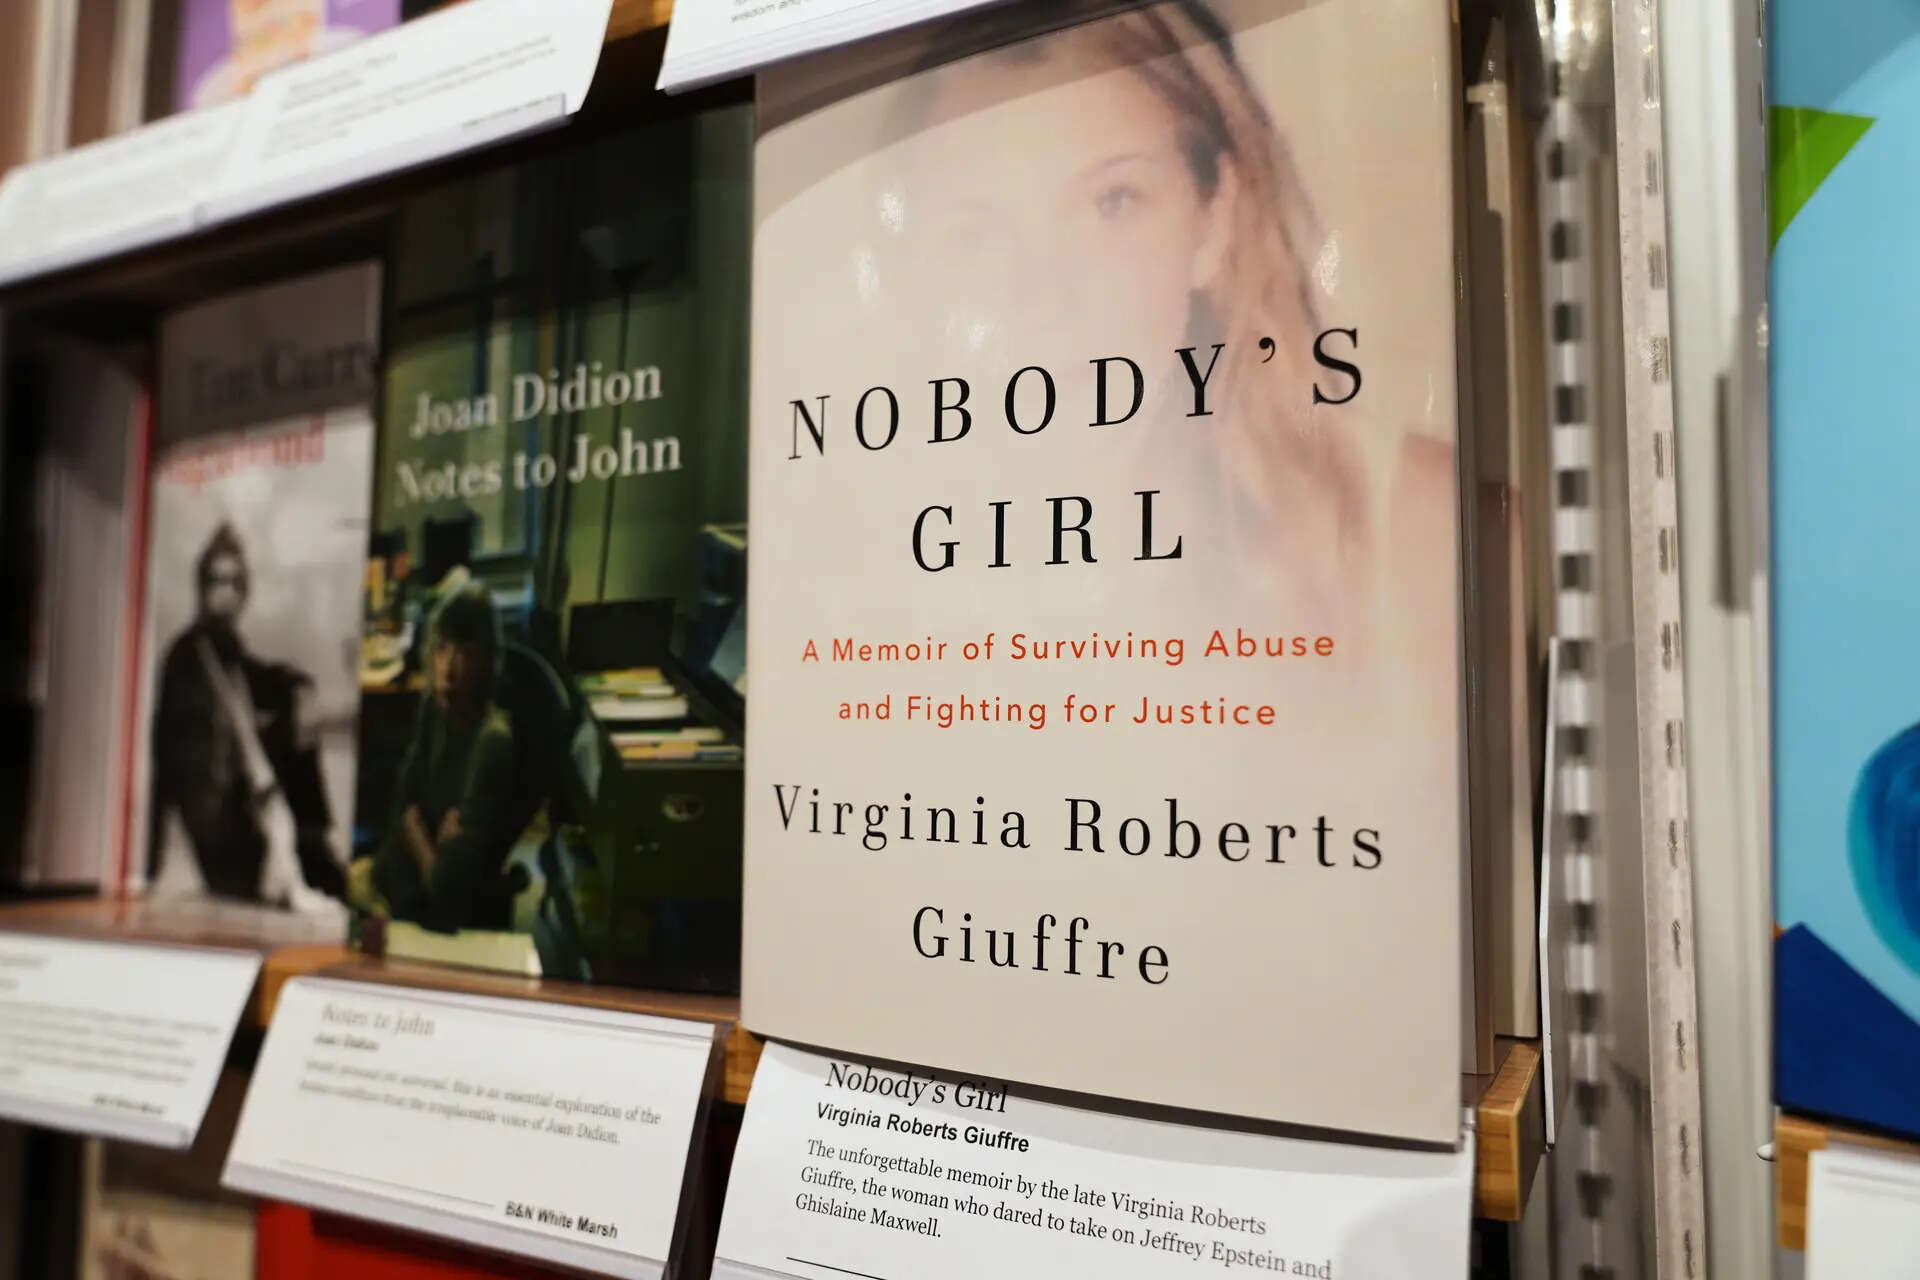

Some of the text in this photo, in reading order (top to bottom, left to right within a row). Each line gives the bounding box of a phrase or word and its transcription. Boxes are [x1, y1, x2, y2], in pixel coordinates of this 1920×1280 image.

[409, 360, 663, 440] Joan Didion
[787, 326, 1364, 461] NOBODY'S
[394, 426, 682, 508] Notes to John
[911, 489, 1184, 573] GIRL
[801, 627, 1335, 666] A Memoir of Surviving Abuse
[838, 693, 1276, 730] and Fighting for Justice
[772, 783, 1384, 871] Virginia Roberts
[912, 905, 1171, 985] Giuffre
[555, 1096, 622, 1119] exploration
[625, 1106, 640, 1122] of
[641, 1108, 662, 1125] the
[825, 1062, 1008, 1113] Nobody's Girl
[546, 1118, 574, 1137] Joan
[817, 1102, 1030, 1153] Virginia Roberts Giuffre
[505, 1201, 618, 1239] B&N White Marsh
[795, 1192, 941, 1238] Ghislaine Maxwell.
[807, 1139, 1267, 1236] The unforgettable memoir by the late Virginia Roberts
[801, 1165, 1332, 1280] Giuffre, the woman who dared to take on Jeffrey Epstein and
